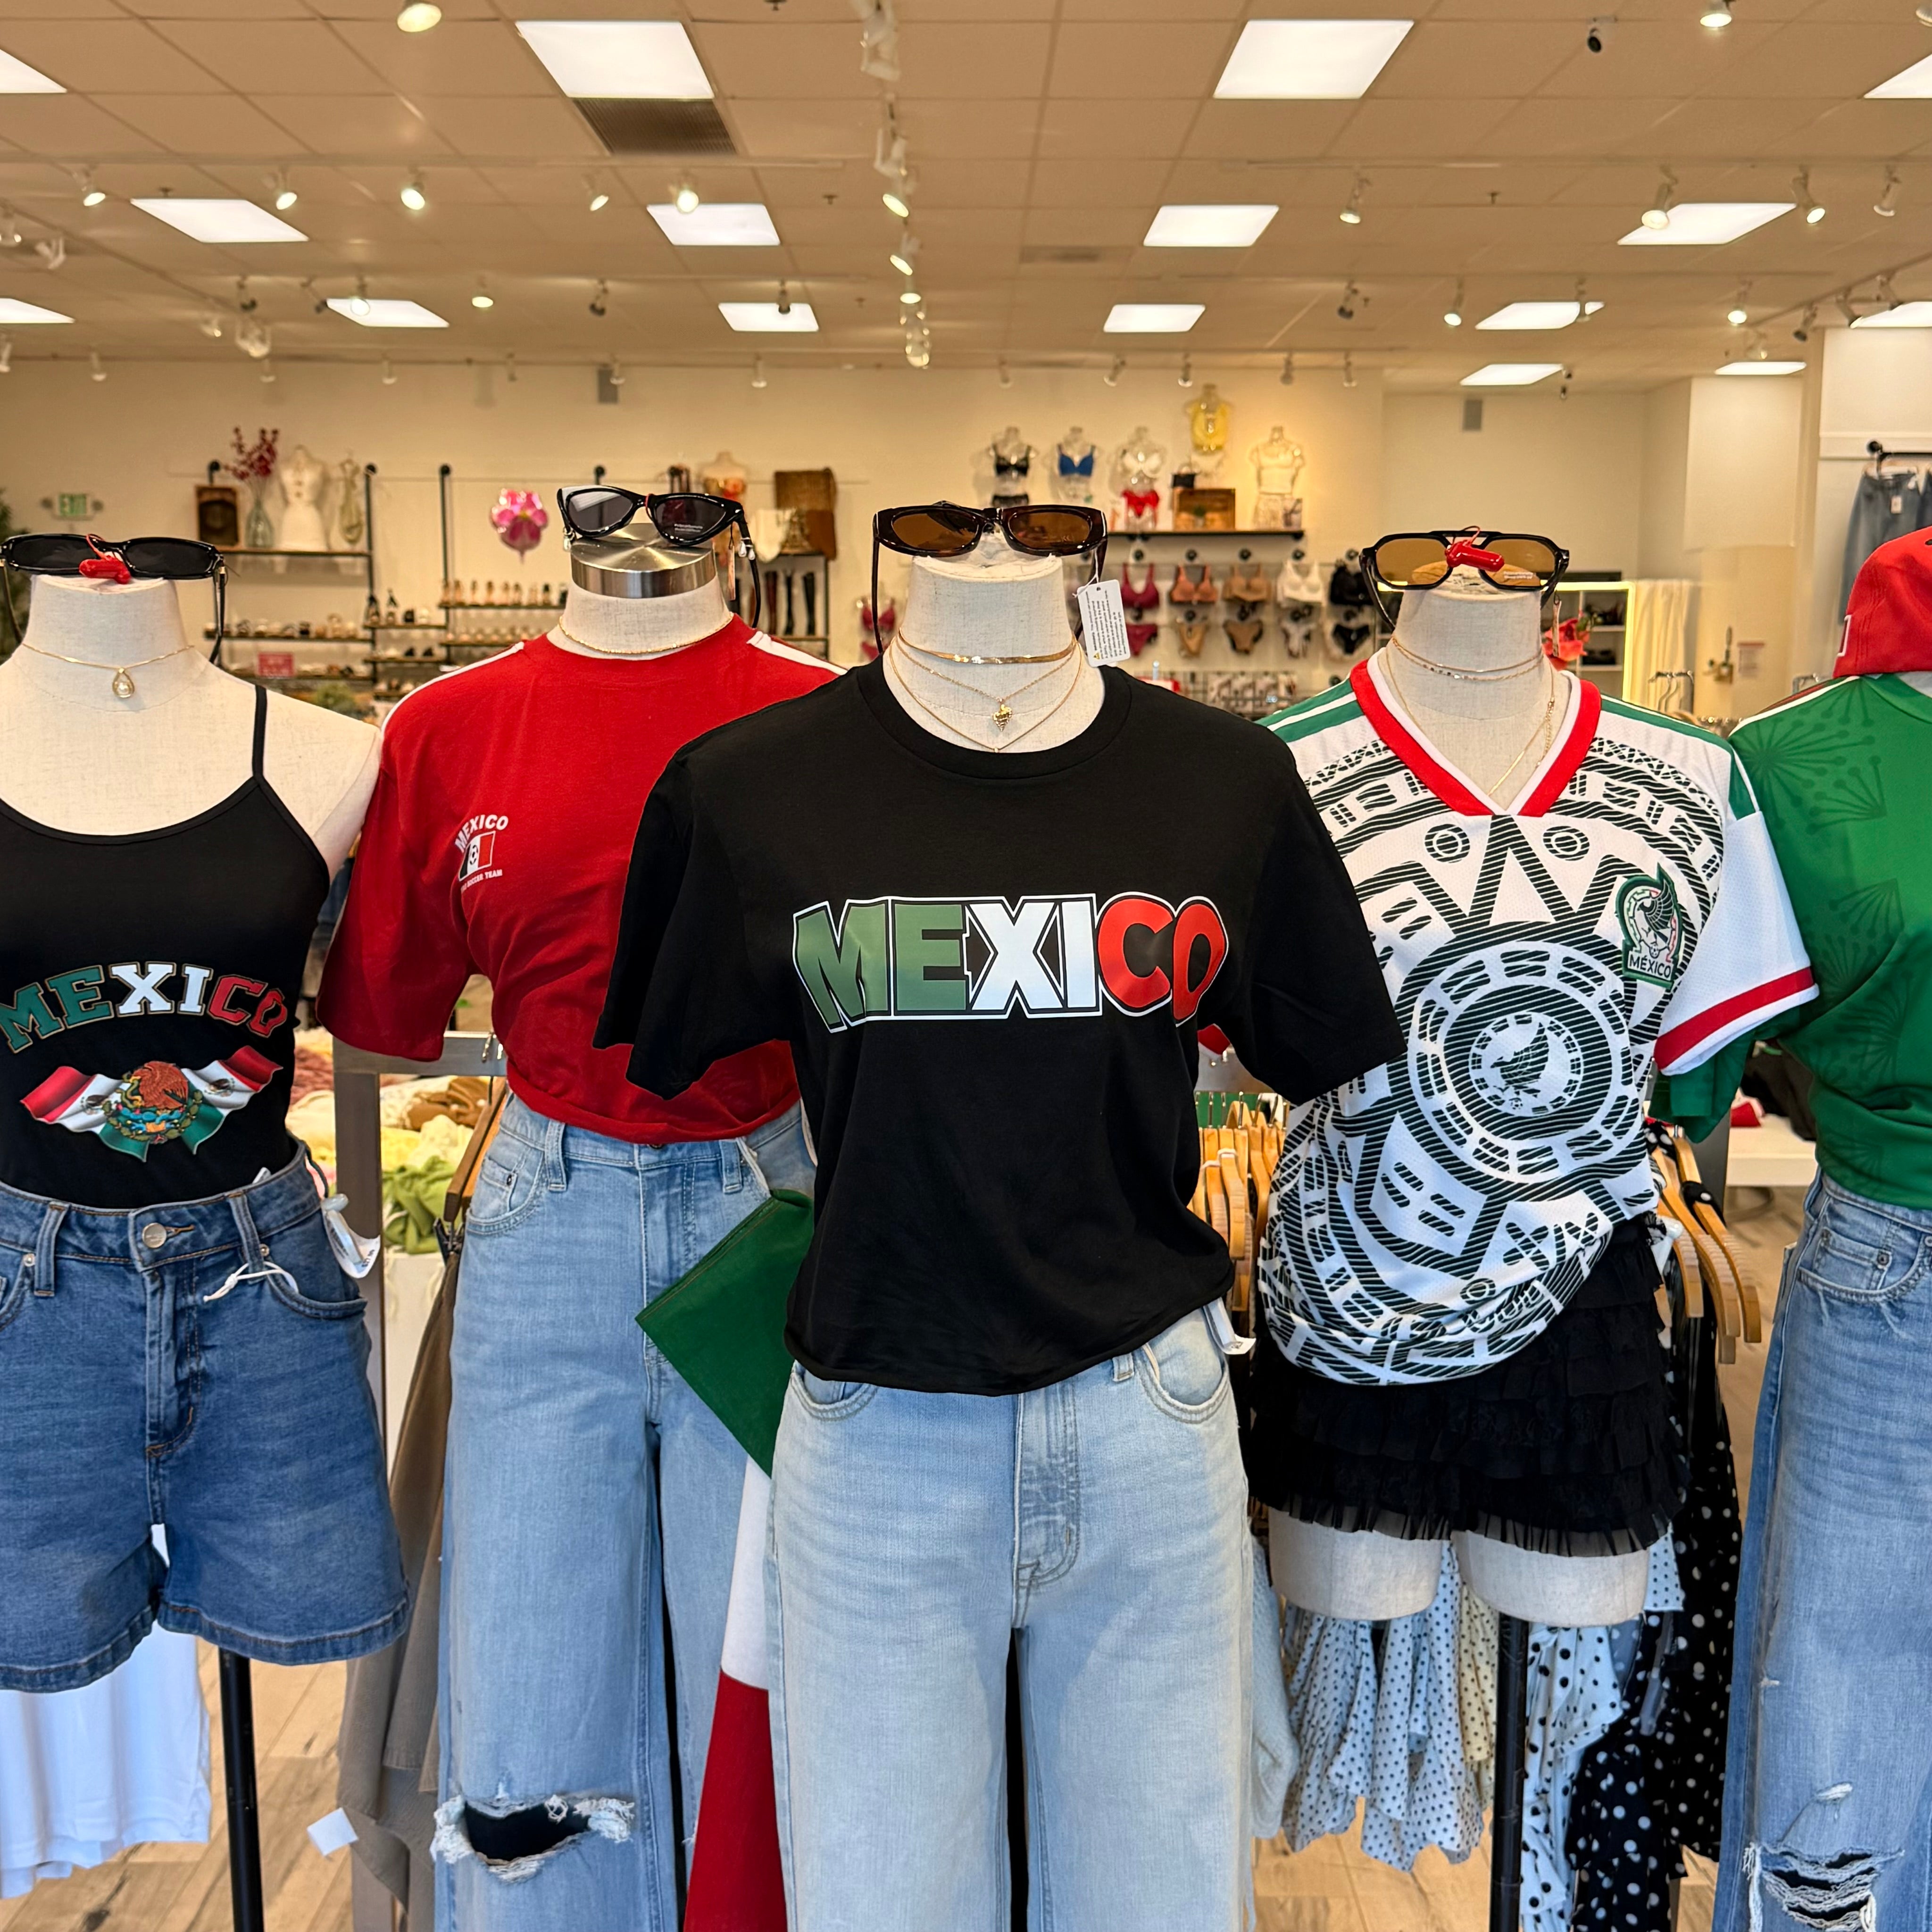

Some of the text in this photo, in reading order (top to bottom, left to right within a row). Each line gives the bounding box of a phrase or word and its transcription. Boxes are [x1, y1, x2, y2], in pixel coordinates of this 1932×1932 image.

[455, 815, 508, 853] MEXICO
[485, 869, 502, 879] TEAM
[793, 891, 1228, 1033] MEXICO
[1630, 954, 1671, 978] MÉXICO
[0, 961, 288, 1053] MEXICO
